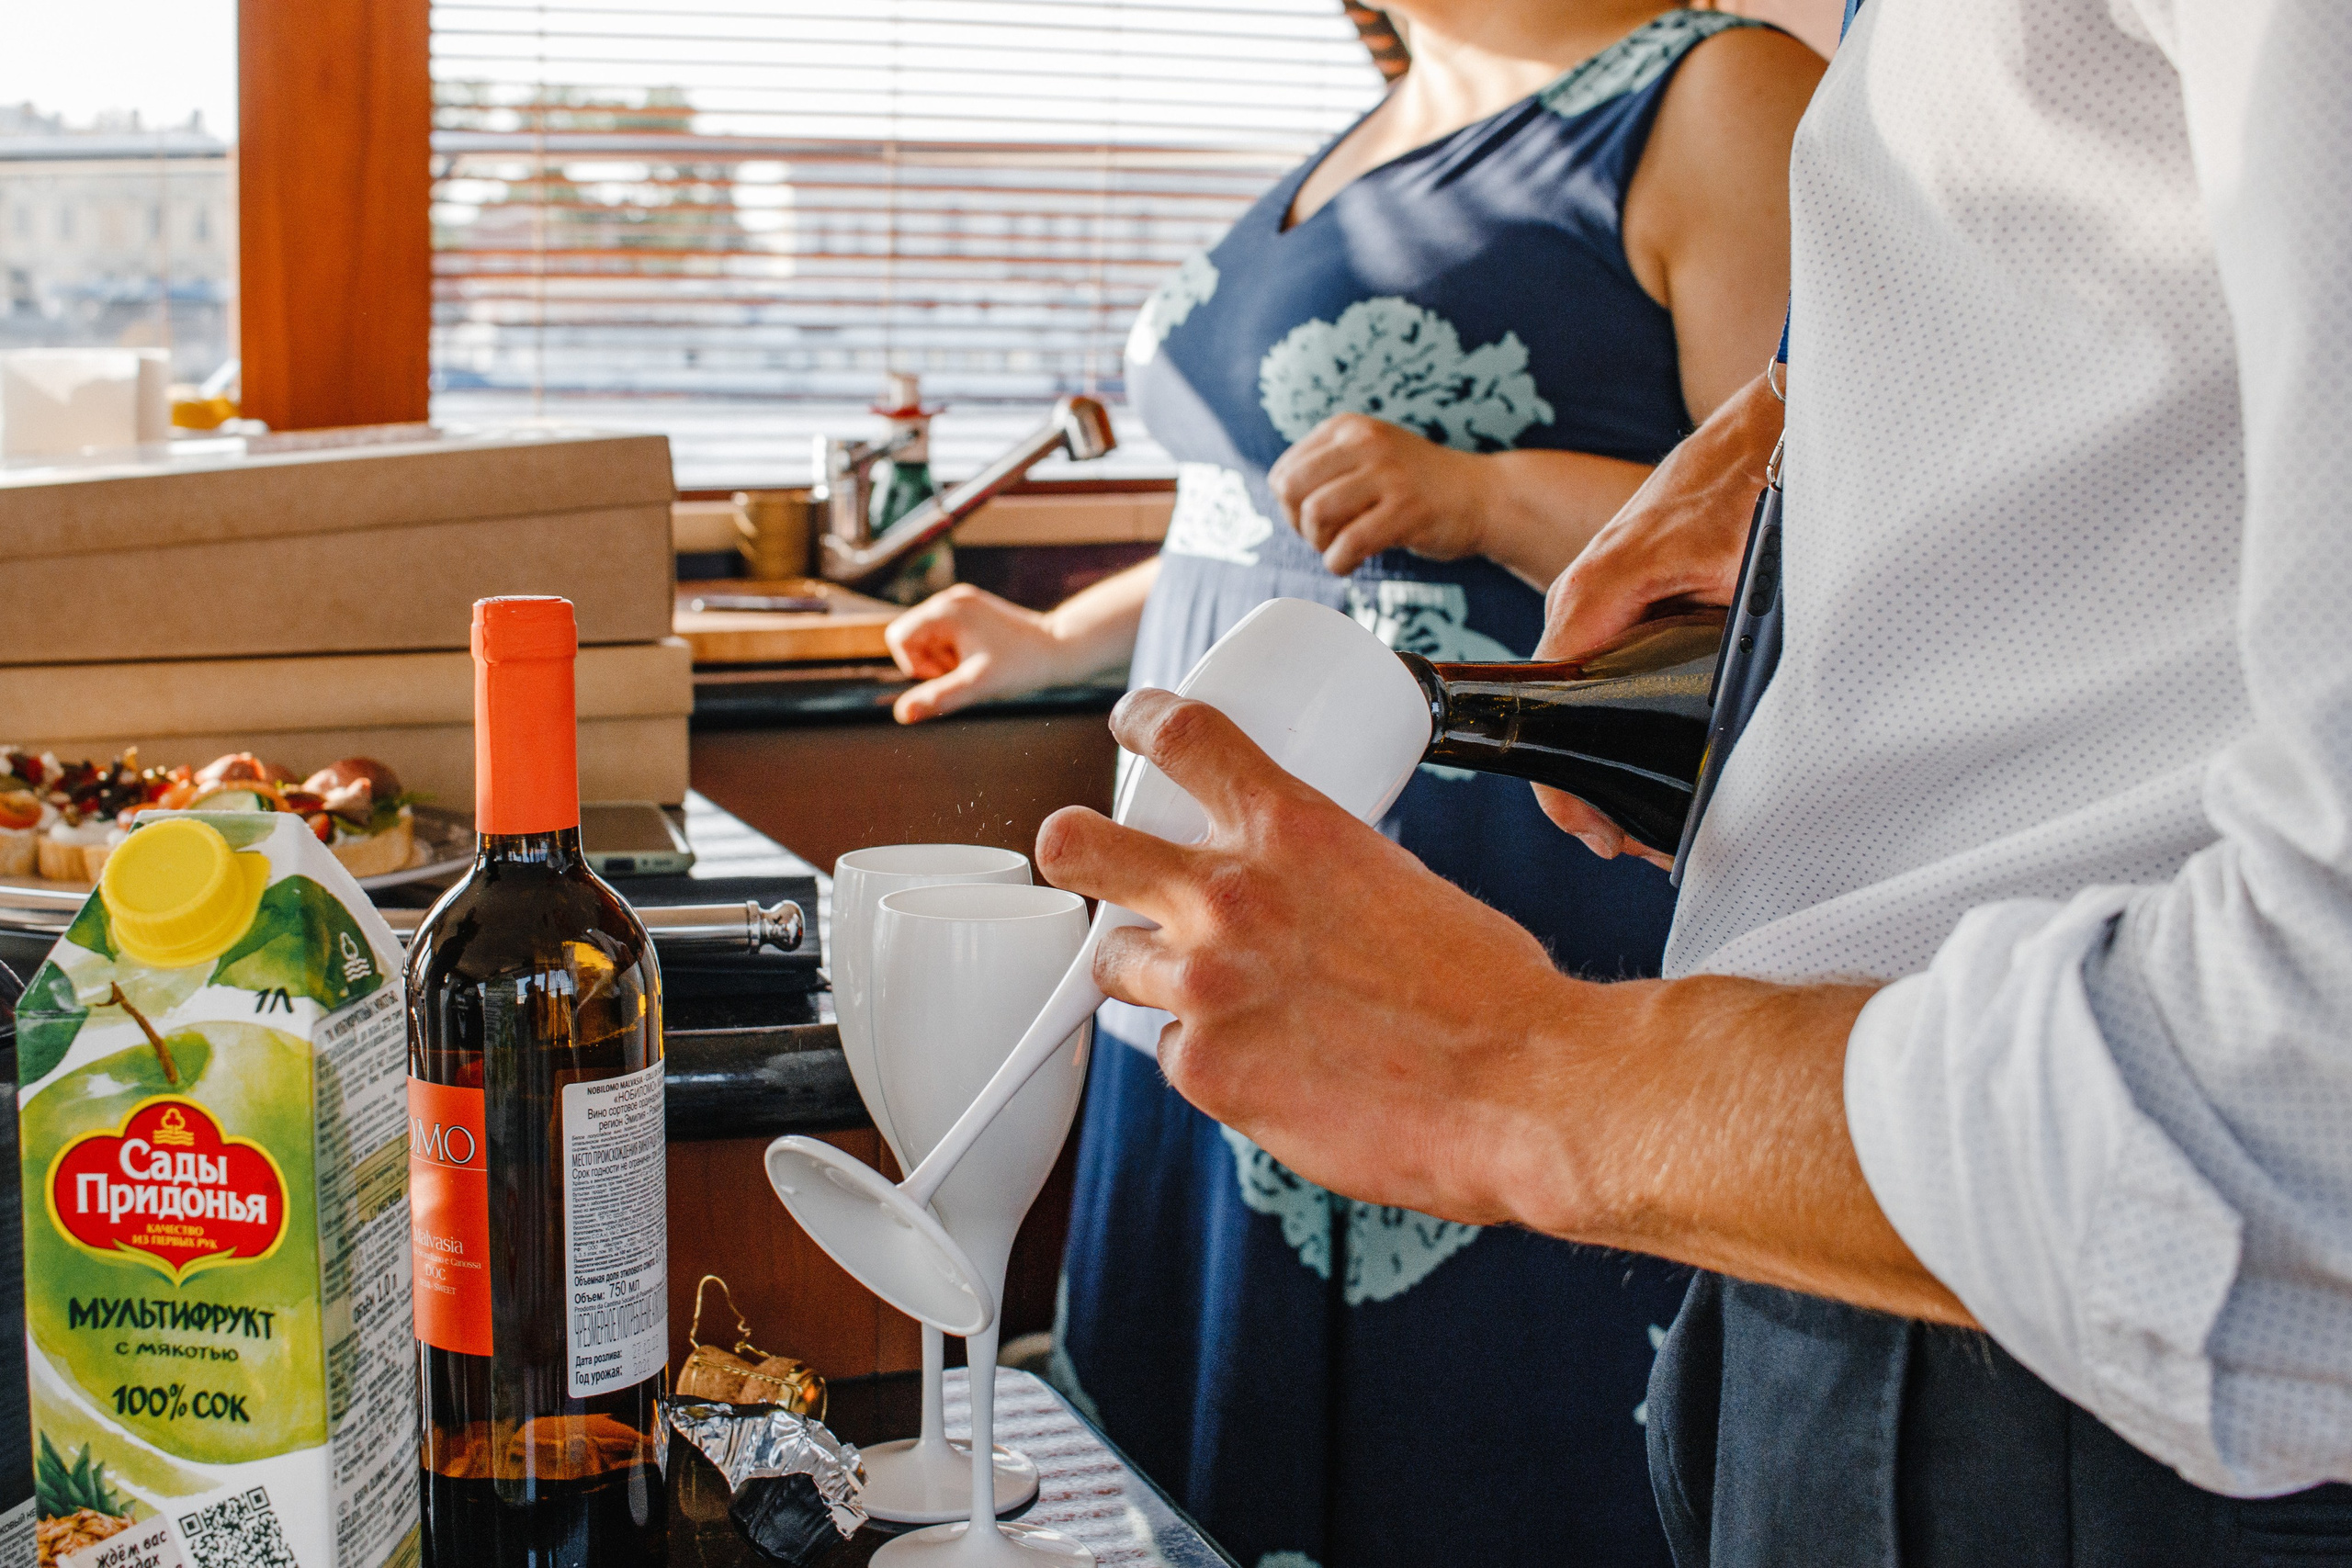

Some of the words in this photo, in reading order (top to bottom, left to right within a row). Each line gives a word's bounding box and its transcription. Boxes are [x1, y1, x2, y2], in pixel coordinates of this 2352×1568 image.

[587, 1082, 619, 1095] NOBILOMO
[620, 1076, 643, 1090] MALVASIA
[588, 1107, 607, 1120] Вино
[609, 1100, 638, 1119] сортовое
[599, 1117, 623, 1133] регион
[119, 1138, 228, 1186] Сады
[572, 1153, 592, 1168] МЕСТО
[572, 1168, 590, 1180] Срок
[592, 1165, 619, 1178] годности
[621, 1162, 628, 1170] не
[76, 1173, 268, 1224] Придонья
[146, 1223, 205, 1237] КАЧЕСТВО
[132, 1235, 150, 1246] ИЗ
[151, 1235, 196, 1248] ПЕРВЫХ
[197, 1239, 219, 1250] РУК
[424, 1263, 447, 1281] DOC
[575, 1273, 605, 1286] Объемная
[606, 1272, 619, 1283] доля
[575, 1291, 605, 1303] Объем:
[609, 1280, 626, 1298] 750
[628, 1280, 639, 1293] мл
[575, 1304, 596, 1313] Prodotto
[69, 1297, 275, 1339] МУЛЬТИФРУКТ
[576, 1355, 592, 1368] Дата
[594, 1350, 622, 1365] розлива:
[576, 1371, 589, 1384] Год
[592, 1367, 623, 1385] урожая:
[112, 1383, 187, 1421] 100%
[192, 1391, 251, 1423] СОК
[143, 1530, 168, 1550] вас
